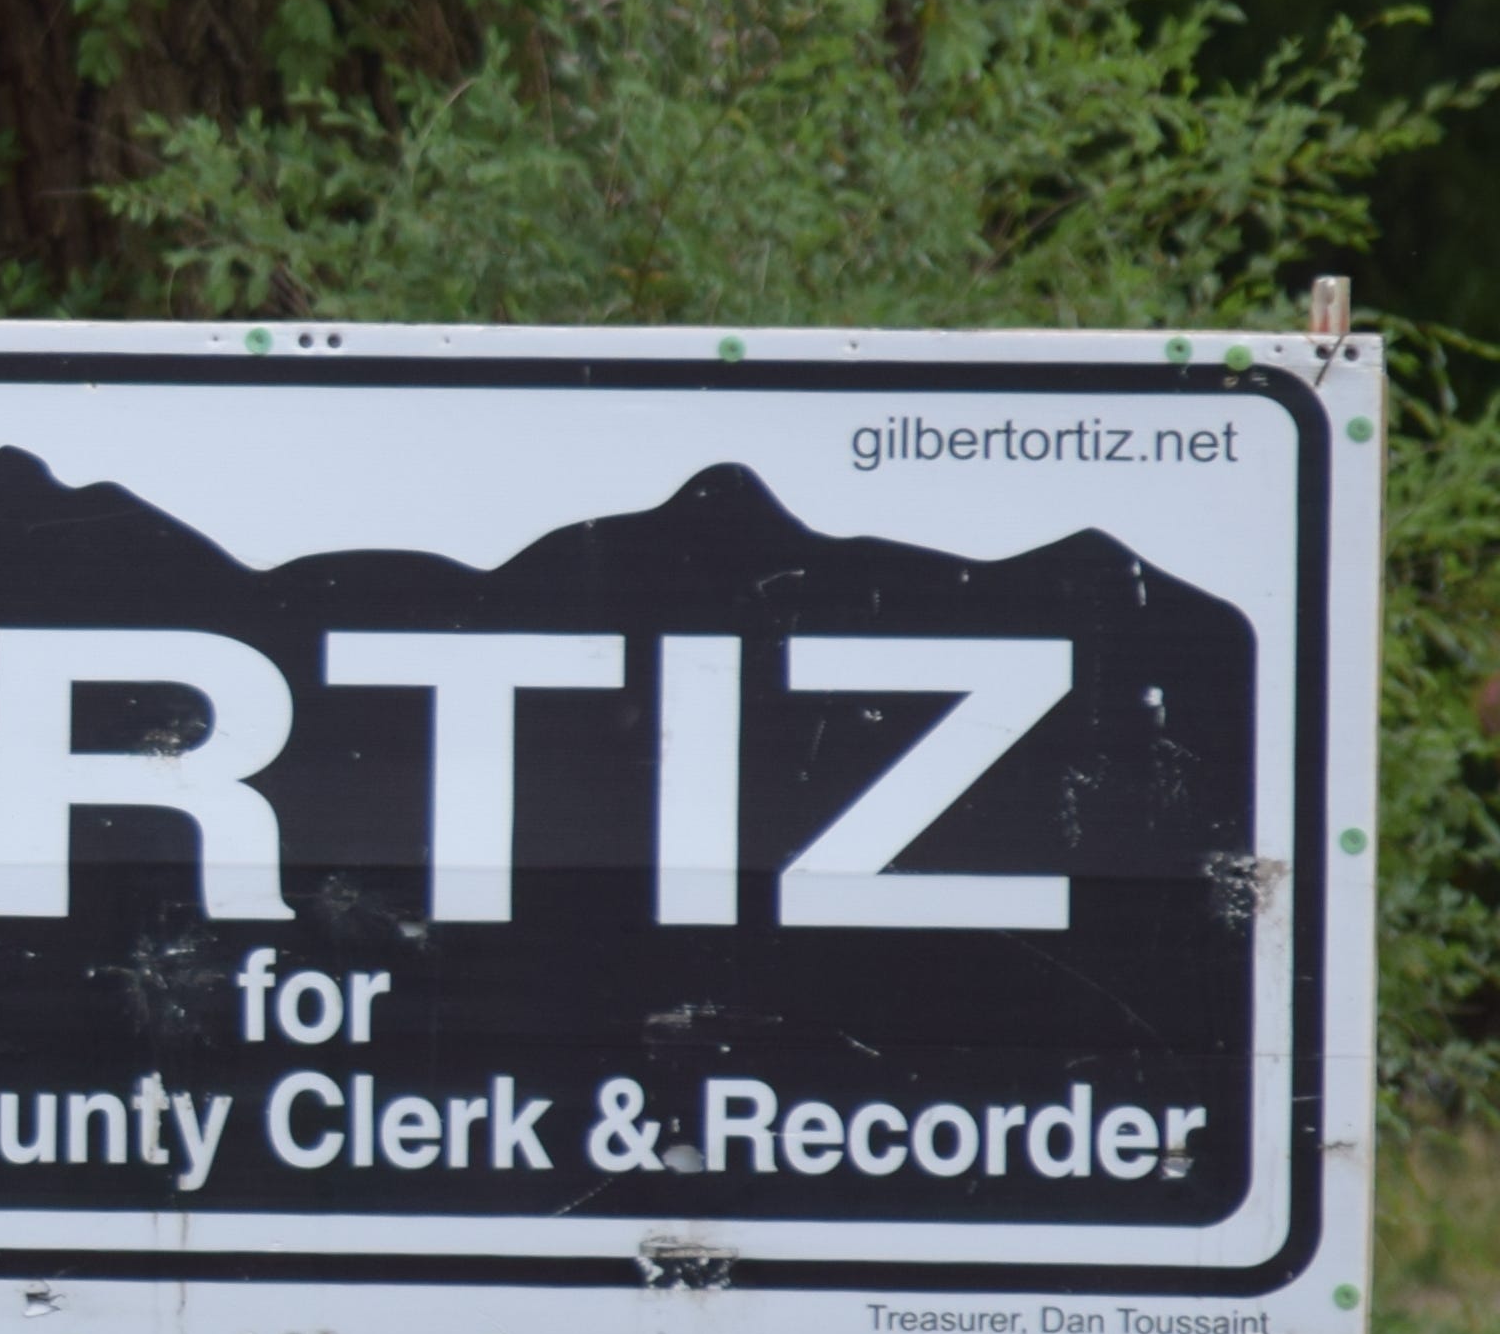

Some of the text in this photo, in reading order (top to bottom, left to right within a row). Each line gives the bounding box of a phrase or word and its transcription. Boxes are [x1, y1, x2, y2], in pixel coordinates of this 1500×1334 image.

[850, 417, 1239, 473] gilbertortiz.net
[236, 947, 391, 1045] for
[266, 1070, 555, 1171] Clerk
[587, 1077, 664, 1173] &
[703, 1077, 1207, 1182] Recorder
[1040, 1306, 1106, 1334] Dan
